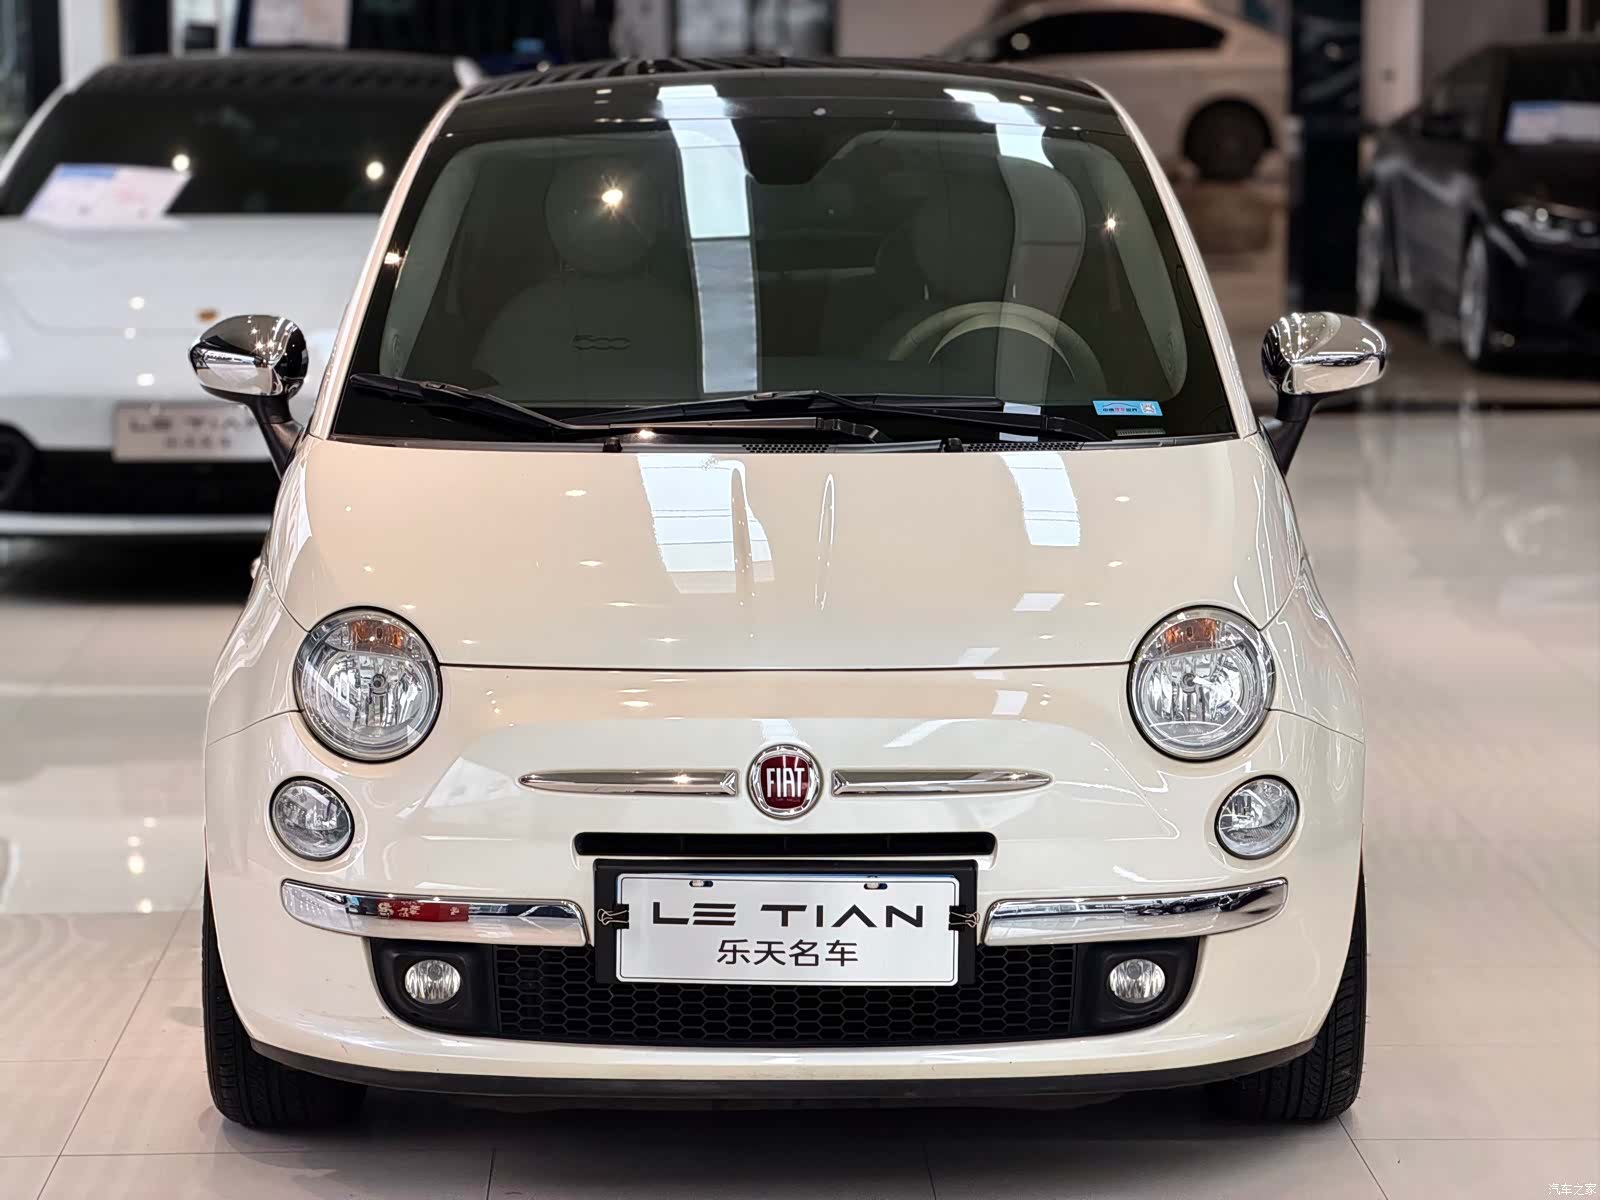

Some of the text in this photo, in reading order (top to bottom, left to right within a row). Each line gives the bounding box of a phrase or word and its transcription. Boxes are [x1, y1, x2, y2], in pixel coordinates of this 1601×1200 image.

[766, 767, 805, 798] FIAT
[652, 901, 924, 928] LE TIAN
[716, 938, 859, 967] 乐天名车
